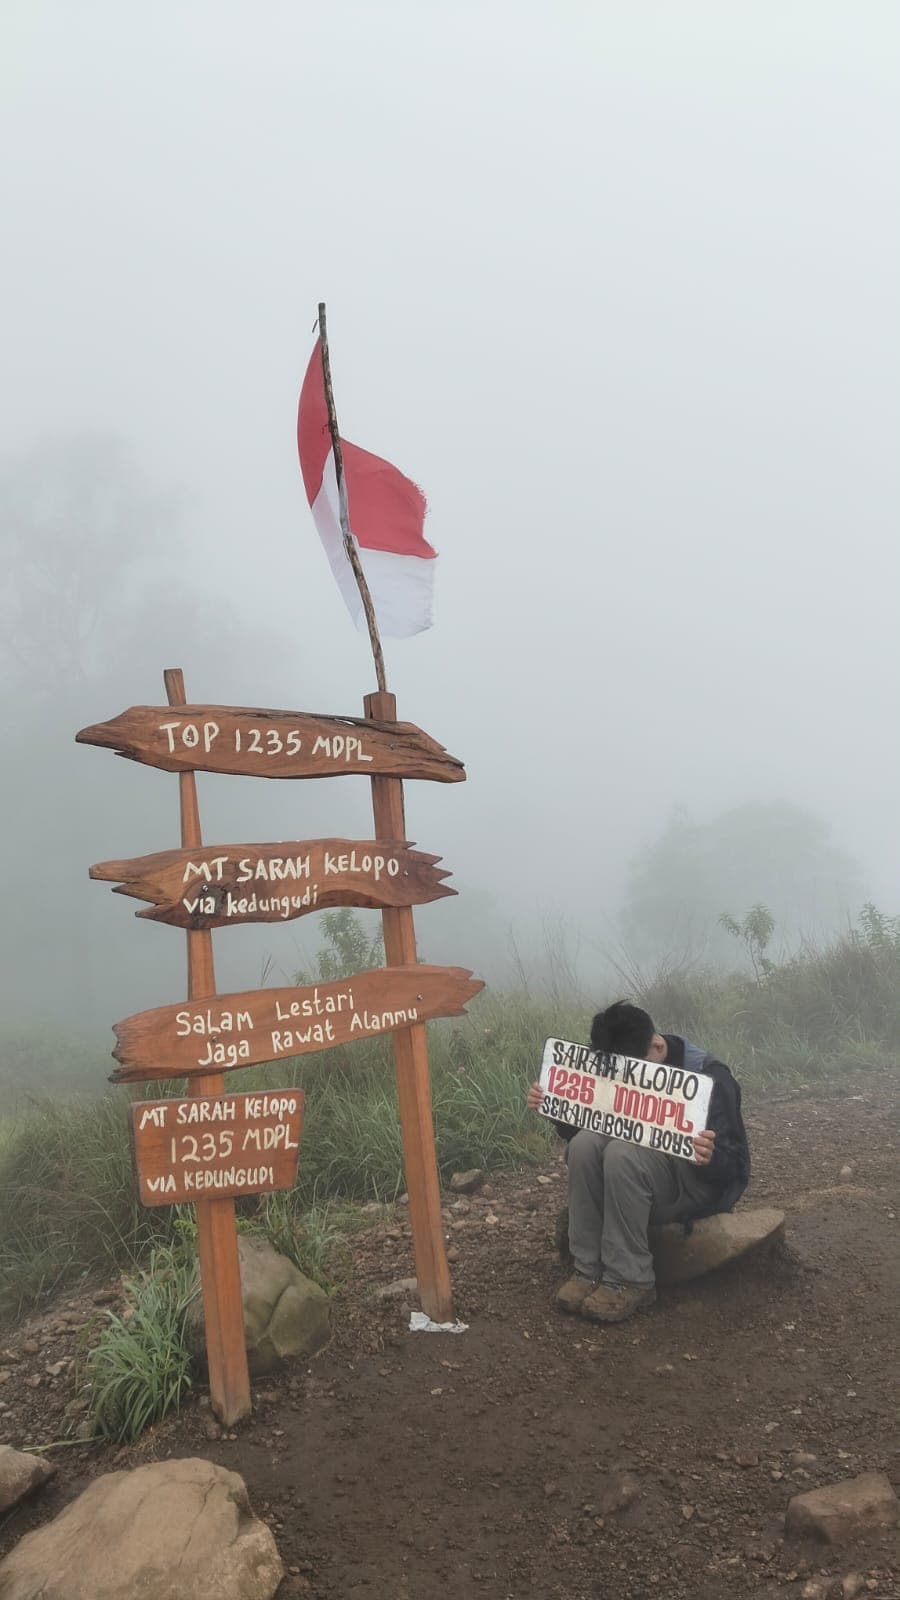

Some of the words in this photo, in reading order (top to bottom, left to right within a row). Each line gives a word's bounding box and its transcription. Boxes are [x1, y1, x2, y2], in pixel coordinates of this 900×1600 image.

[159, 721, 221, 753] TOP
[234, 728, 302, 756] 1235
[311, 735, 373, 761] MDPL
[182, 856, 229, 883] MT
[236, 855, 311, 882] SARAH
[182, 895, 216, 915] via
[226, 884, 319, 918] kedungudi
[275, 988, 354, 1021] Lestari
[198, 1039, 250, 1067] Jaga
[271, 1018, 336, 1054] Rawat
[547, 1065, 596, 1105] 1235
[552, 1041, 619, 1081] SARAH
[624, 1059, 699, 1101] KLOPO
[139, 1106, 168, 1130] MT
[176, 1101, 236, 1125] SARAH
[170, 1131, 235, 1164] 1235
[242, 1124, 299, 1151] MDPL
[649, 1126, 695, 1158] BOYS
[147, 1174, 177, 1194] VIA
[184, 1167, 274, 1191] KEDUNGUDI
